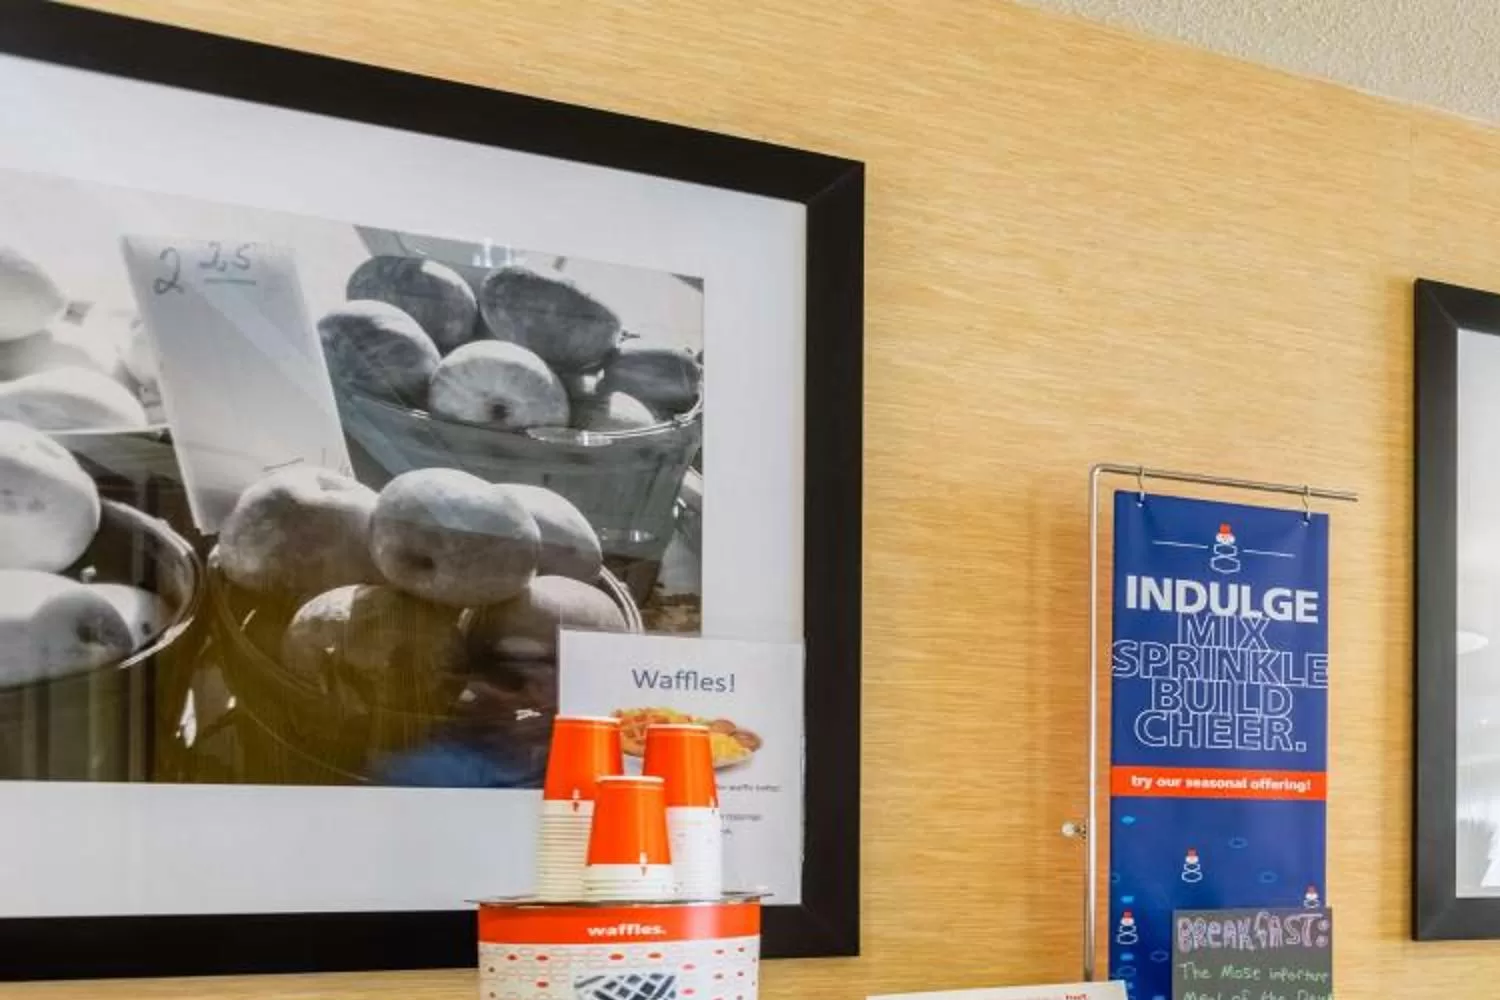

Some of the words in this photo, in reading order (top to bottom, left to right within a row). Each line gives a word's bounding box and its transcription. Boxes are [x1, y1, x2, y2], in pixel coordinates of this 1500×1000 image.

[1126, 575, 1319, 624] INDULGE
[1178, 612, 1270, 652] MIX
[632, 668, 736, 692] Waffles!
[1112, 639, 1328, 689] SPRINKLE
[1152, 677, 1293, 718] BUILD
[1135, 709, 1307, 752] CHEER.
[1131, 775, 1152, 789] try
[1155, 777, 1181, 788] our
[1185, 776, 1247, 790] seasonal
[1251, 778, 1311, 793] offering!
[587, 923, 666, 937] waffles.
[1178, 961, 1211, 980] The
